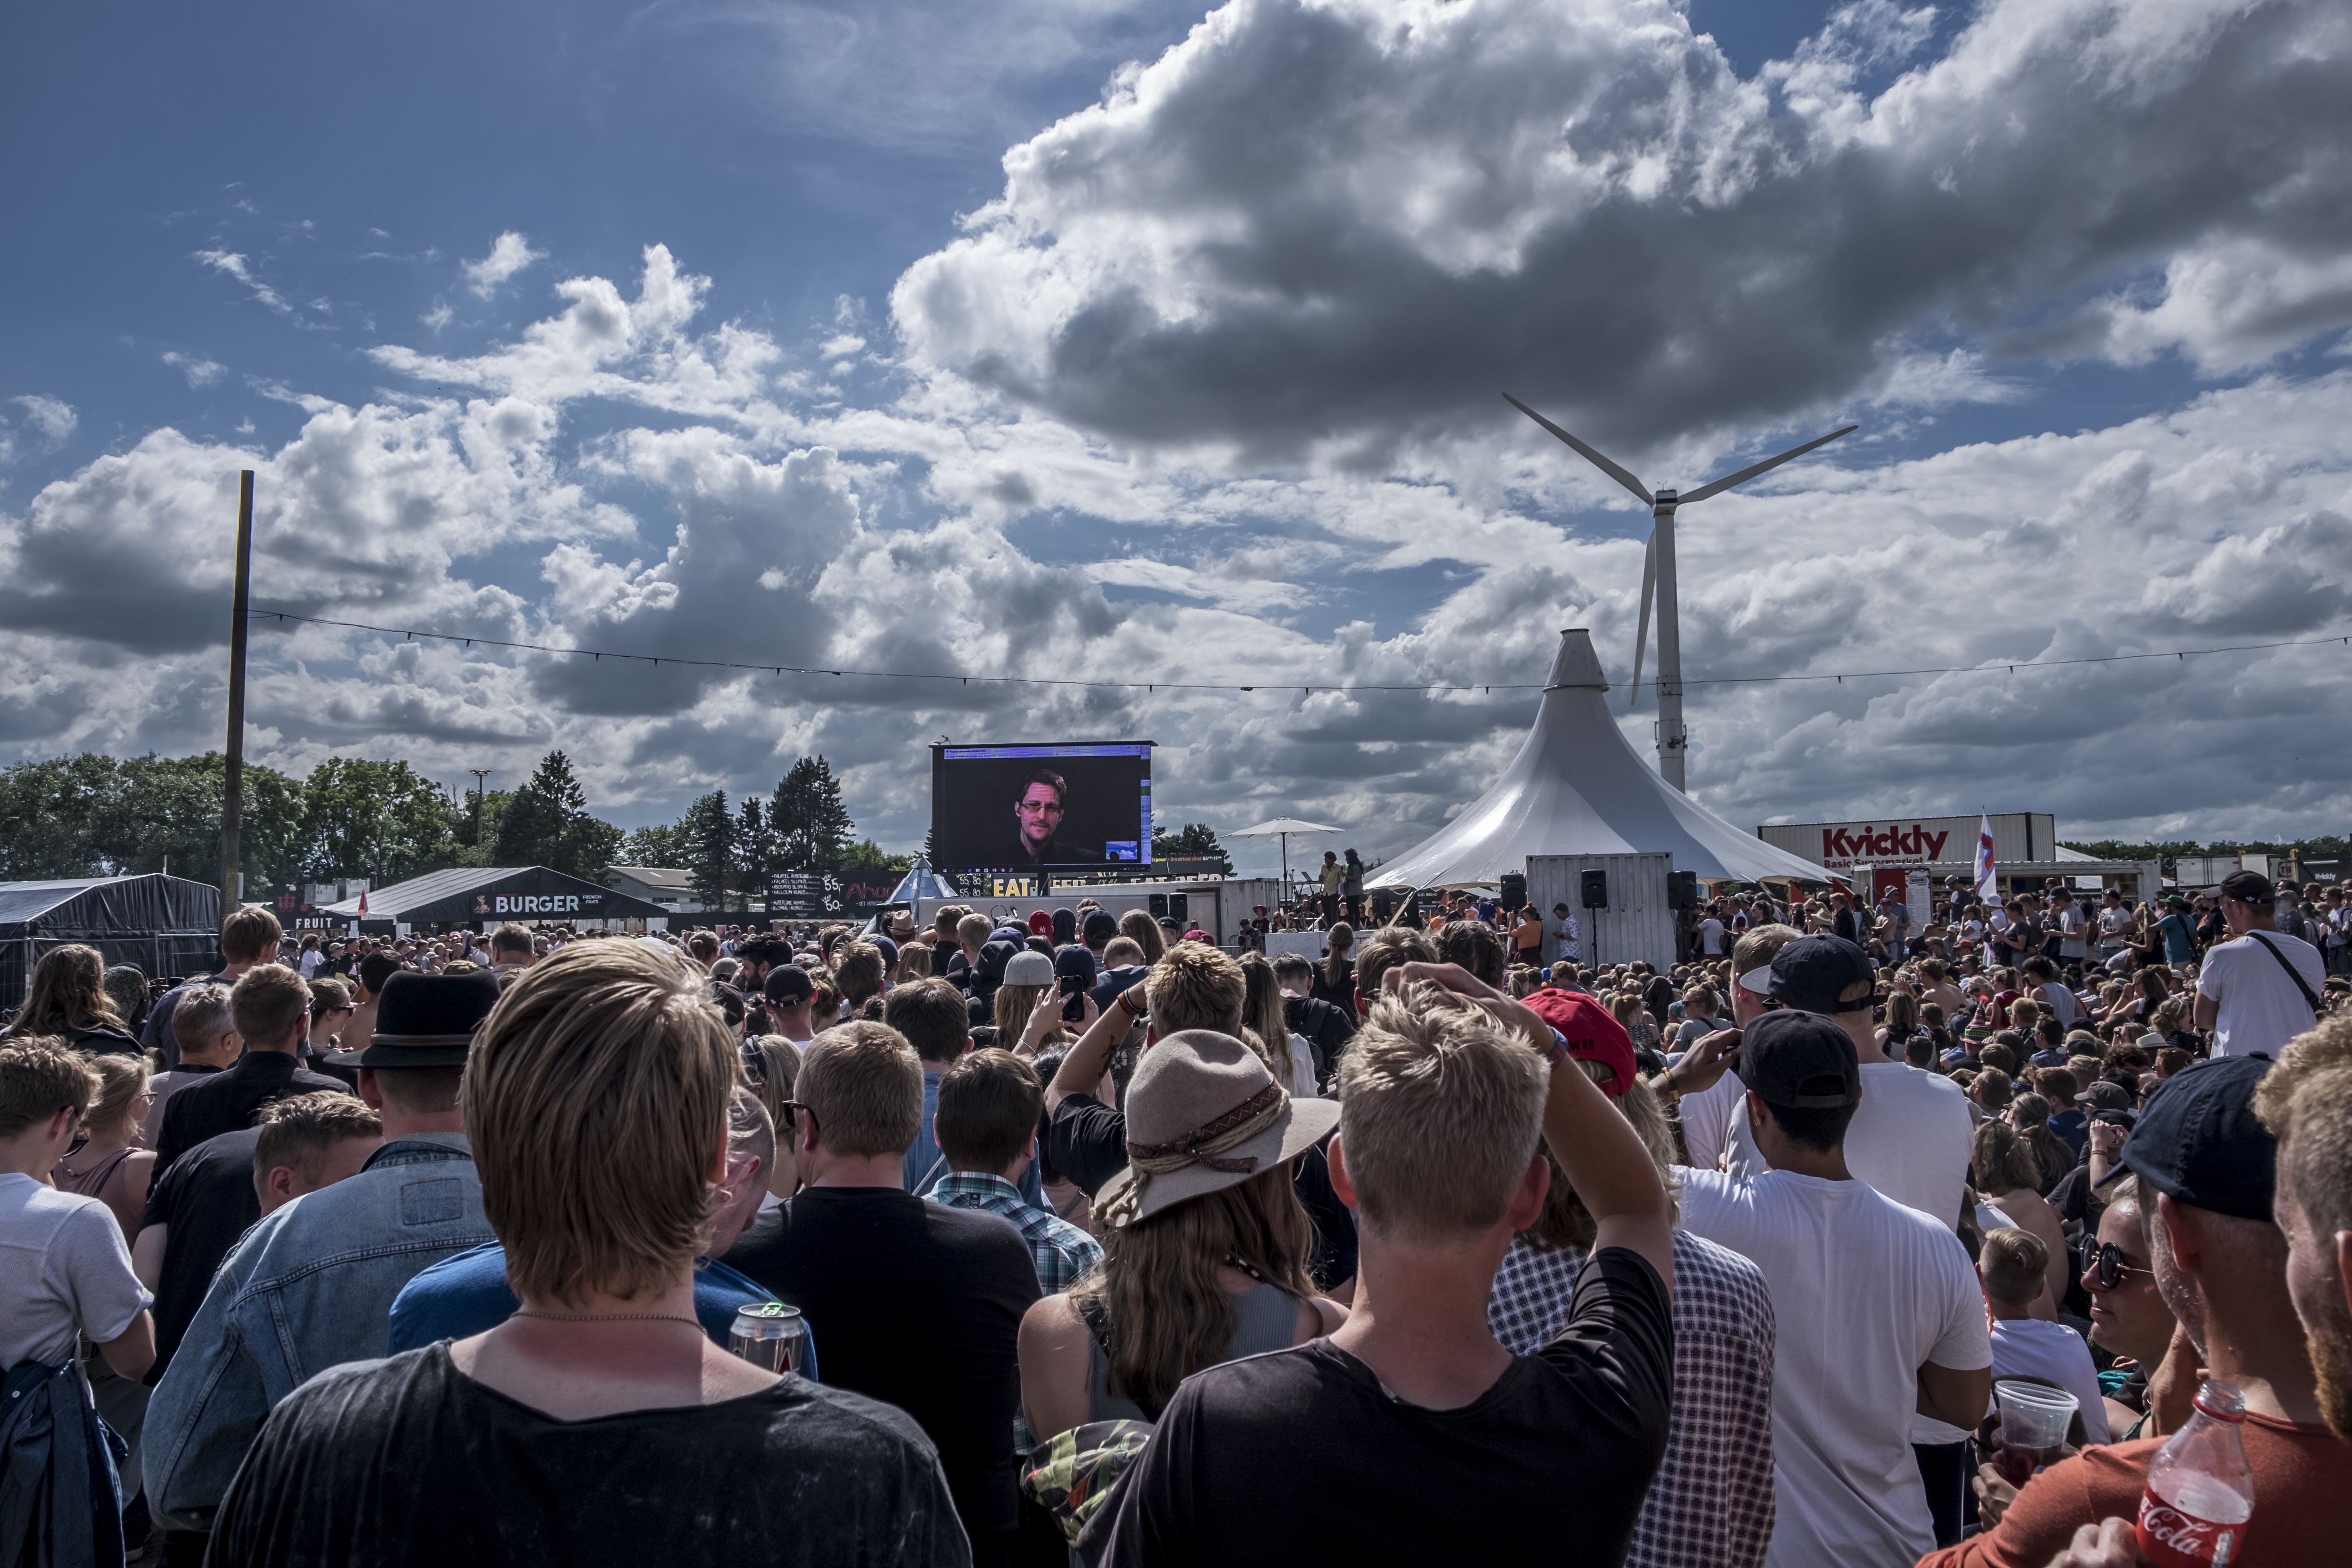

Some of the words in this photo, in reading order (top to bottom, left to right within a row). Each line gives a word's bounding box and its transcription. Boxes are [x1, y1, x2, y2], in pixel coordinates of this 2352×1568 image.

[1823, 824, 1949, 860] Kvickly
[1824, 859, 1852, 869] Basic
[993, 878, 1030, 897] EAT
[496, 895, 579, 913] BURGER
[296, 918, 332, 929] FRUIT
[2144, 1507, 2213, 1555] Cola
